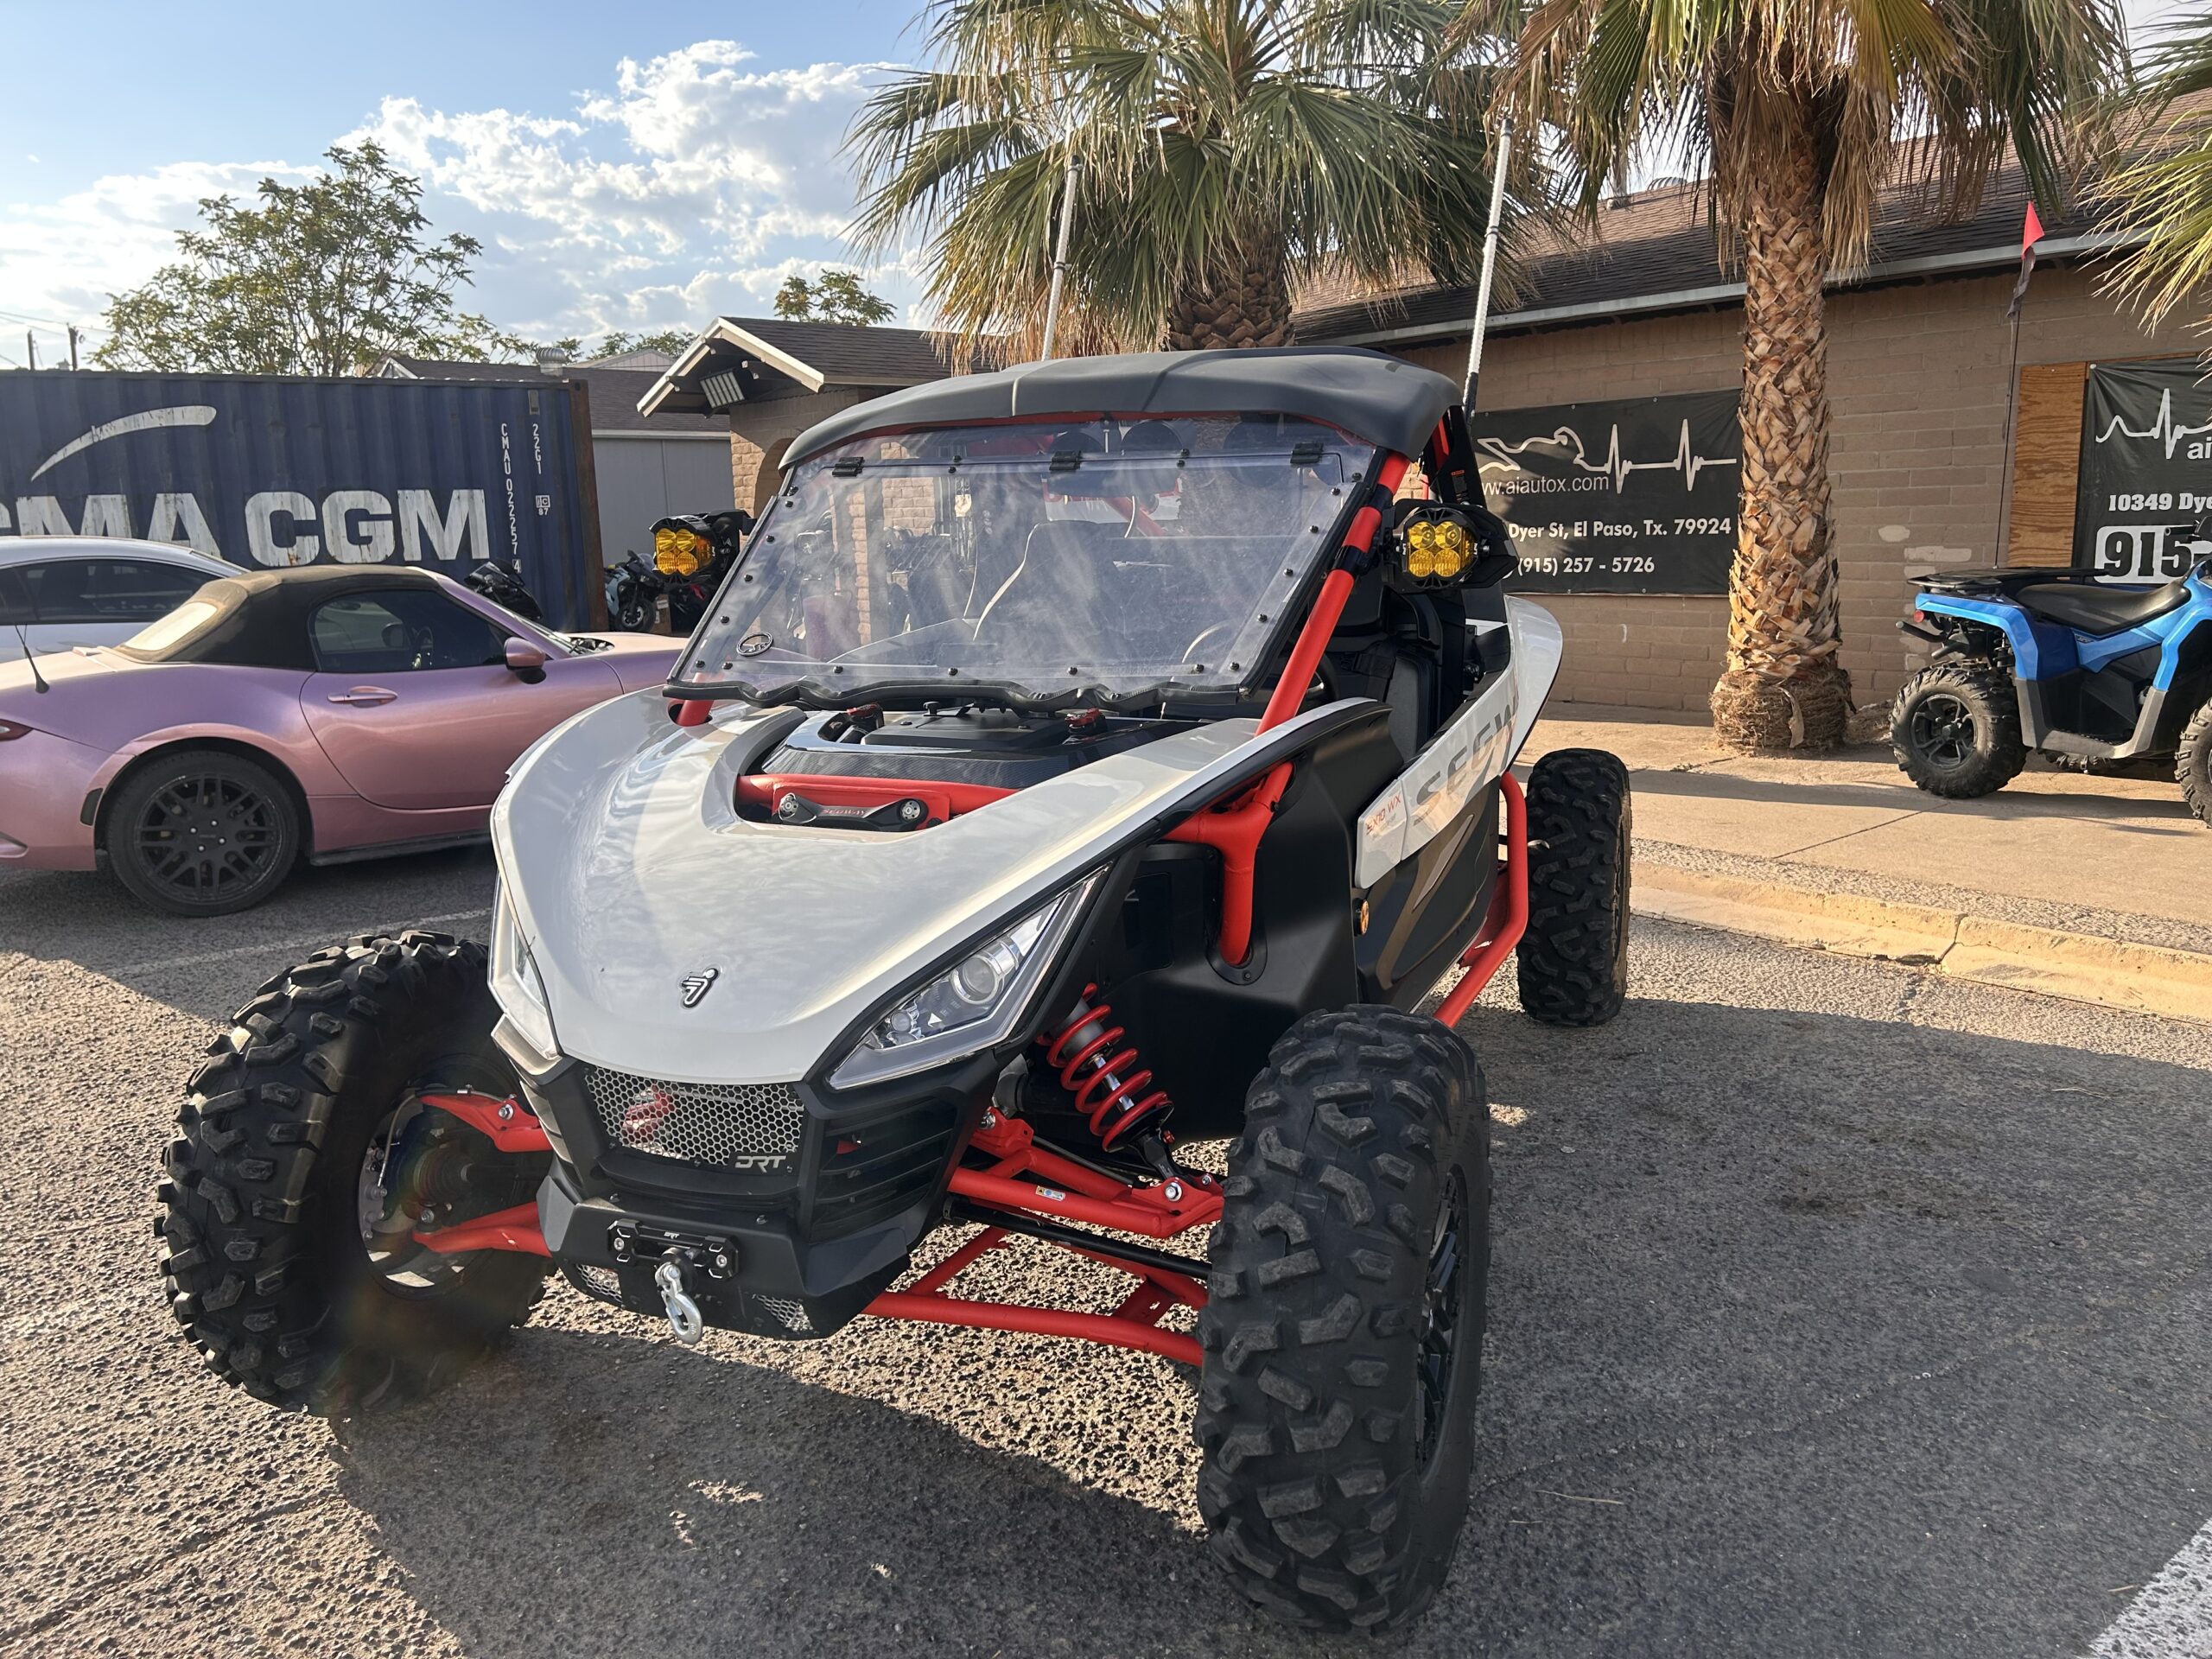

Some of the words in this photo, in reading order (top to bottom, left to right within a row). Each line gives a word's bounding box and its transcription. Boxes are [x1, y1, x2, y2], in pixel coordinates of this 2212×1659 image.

[500, 423, 512, 475] CMAU
[532, 423, 543, 475] 22G1
[538, 507, 549, 516] 87
[2108, 493, 2173, 512] 10349
[0, 493, 223, 560] MA
[245, 488, 491, 567] CGM
[505, 478, 518, 555] 022257
[1508, 523, 1545, 543] Dyer
[1548, 522, 1569, 540] St,
[1573, 520, 1588, 537] El
[1592, 520, 1638, 539] Paso,
[1643, 519, 1668, 536] Tx.
[1674, 518, 1732, 535] 79924
[1517, 556, 1558, 576] (915)
[1563, 557, 1594, 573] 257
[1611, 556, 1656, 573] 5726
[734, 1155, 786, 1173] DRT
